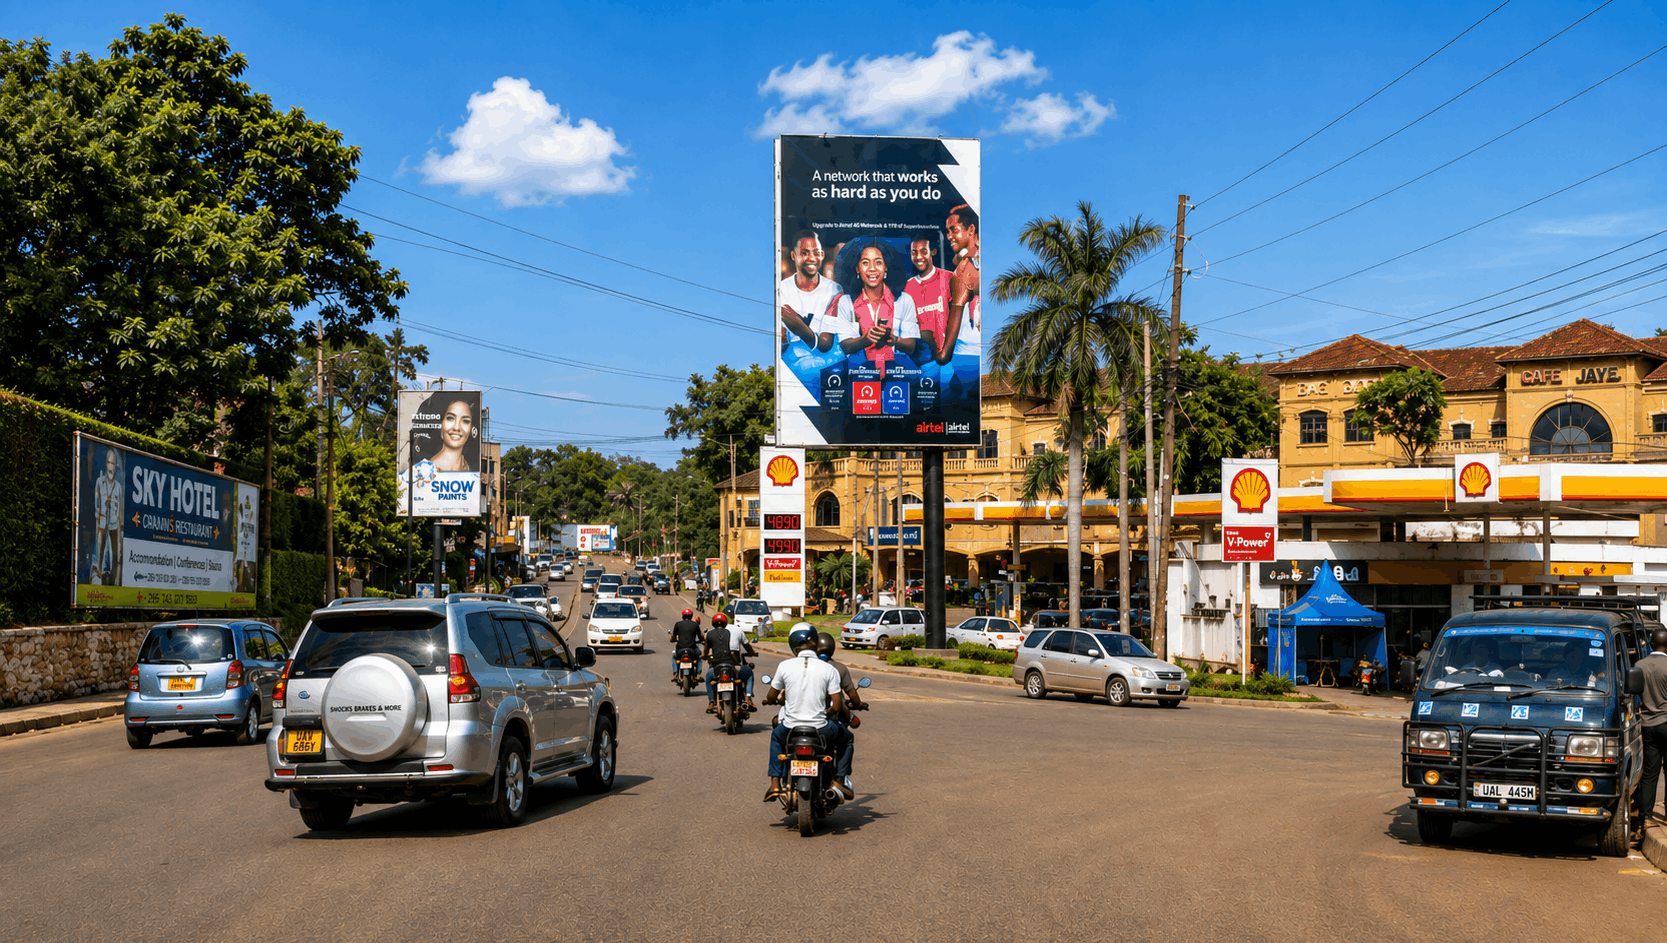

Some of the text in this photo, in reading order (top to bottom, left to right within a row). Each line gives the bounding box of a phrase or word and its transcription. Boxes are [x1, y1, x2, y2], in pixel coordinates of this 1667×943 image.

[812, 170, 938, 183] A network that works
[812, 184, 941, 203] as hard as you do
[1521, 366, 1622, 386] CAFE JAYE
[916, 421, 944, 433] airtel
[132, 465, 220, 520] SKY HOTEL
[431, 480, 475, 493] SNOW
[438, 493, 467, 501] PAINTS
[767, 515, 799, 529] 4890
[767, 540, 799, 553] 4990
[1482, 784, 1502, 797] UAL
